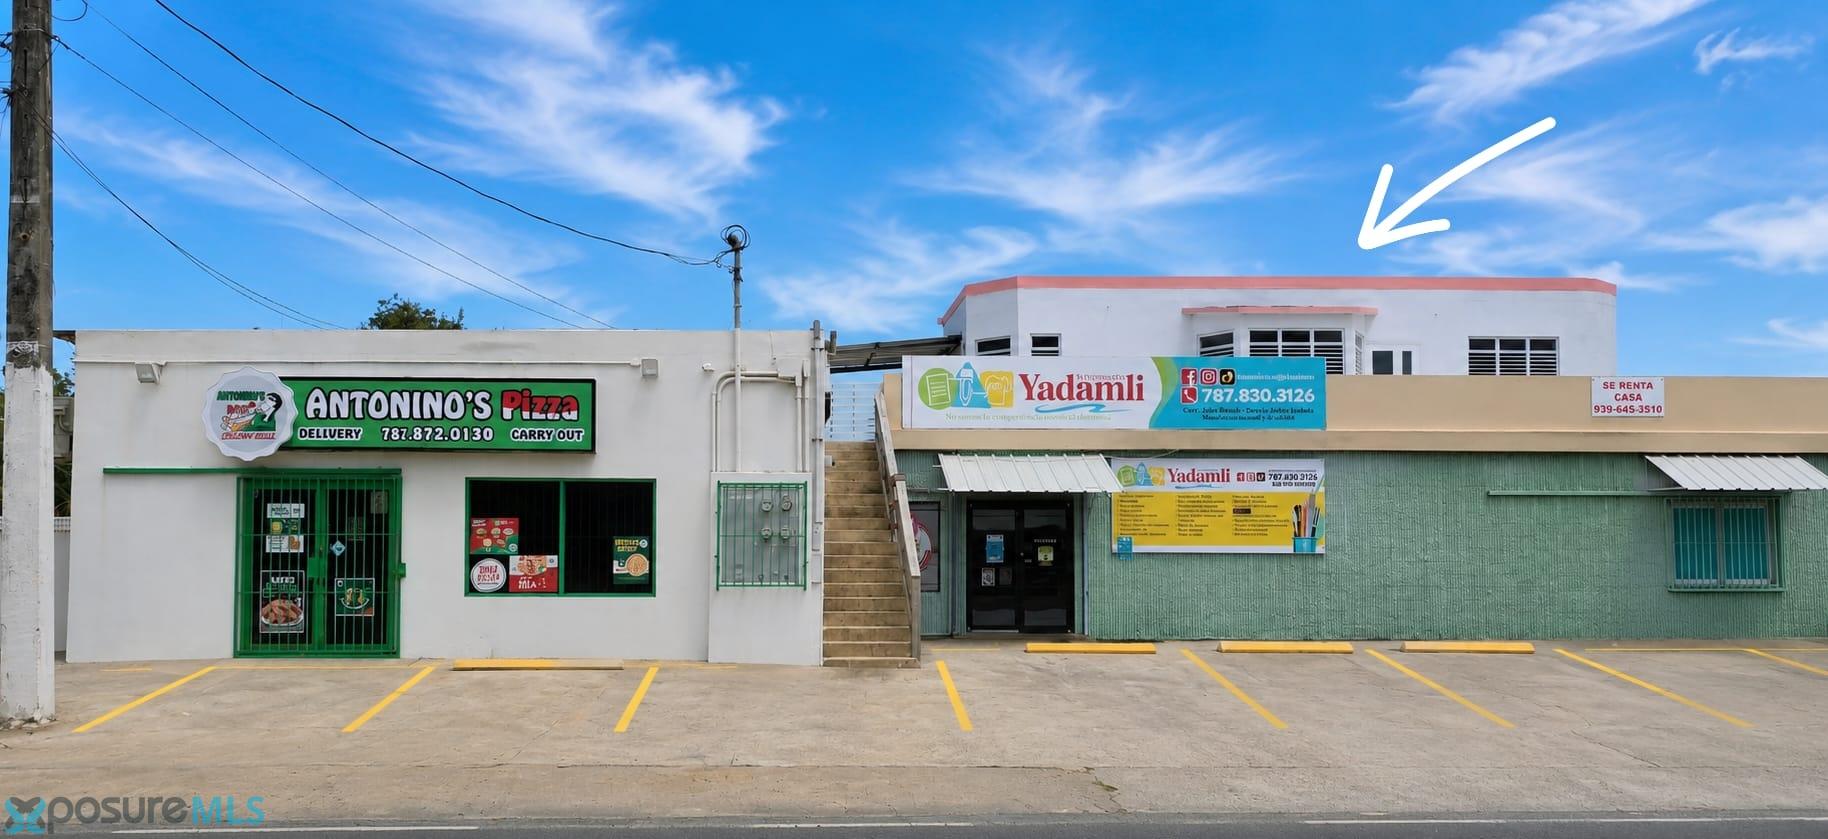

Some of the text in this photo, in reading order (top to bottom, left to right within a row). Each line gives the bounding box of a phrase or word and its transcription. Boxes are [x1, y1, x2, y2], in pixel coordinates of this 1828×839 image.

[1019, 373, 1145, 402] Yadamli
[1602, 381, 1654, 389] SE RENTA
[1202, 388, 1315, 403] 787.830.3126
[1614, 393, 1643, 401] CASA
[306, 387, 580, 421] ANTONINO'S Pizza
[381, 427, 494, 441] 787.872.0130
[511, 428, 554, 441] CARRY
[556, 429, 584, 441] OUT
[1167, 468, 1231, 483] Yadamli
